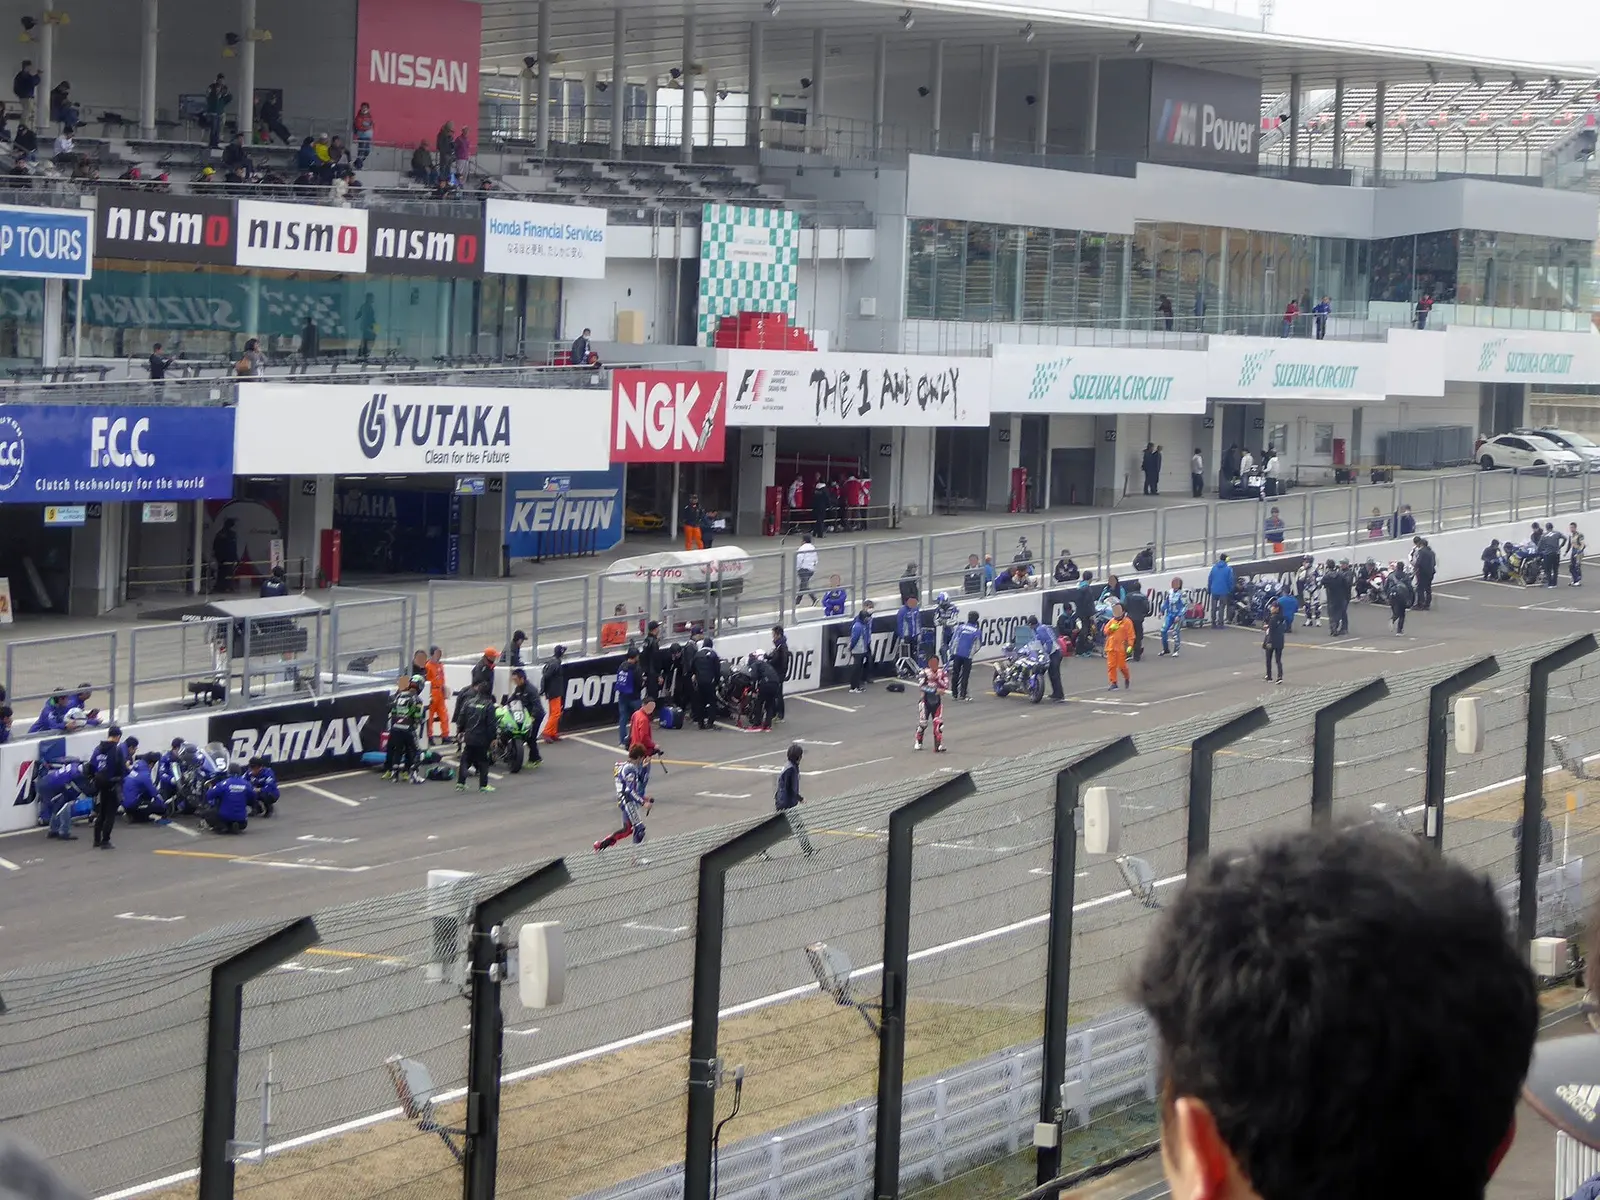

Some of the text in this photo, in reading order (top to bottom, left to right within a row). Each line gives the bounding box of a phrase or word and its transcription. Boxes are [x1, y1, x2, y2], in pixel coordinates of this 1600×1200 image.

[369, 49, 468, 94] NISSAN
[1201, 104, 1256, 154] Power
[17, 226, 82, 261] TOURS
[106, 206, 230, 247] nismo
[247, 218, 358, 255] nismo
[374, 225, 478, 264] nismo
[489, 218, 603, 242] Honda Financial Services
[1272, 363, 1359, 388] SUZUKA CIRCUIT
[1504, 351, 1574, 374] SUZUKA CIRCUIT
[809, 368, 854, 420] THE
[858, 369, 871, 416] 1
[880, 368, 912, 410] AND
[1069, 374, 1174, 401] SUZUKA CIRCUIT
[393, 404, 511, 447] YUTAKA
[616, 380, 699, 452] NGK
[90, 416, 155, 468] F.C.C.
[425, 450, 510, 464] Clean for the Future
[35, 476, 205, 493] Clutch technology for the world
[333, 493, 397, 518] AMAHA
[510, 496, 614, 533] KEIHIN
[215, 757, 226, 770] 5
[1556, 1085, 1597, 1122] adidas
